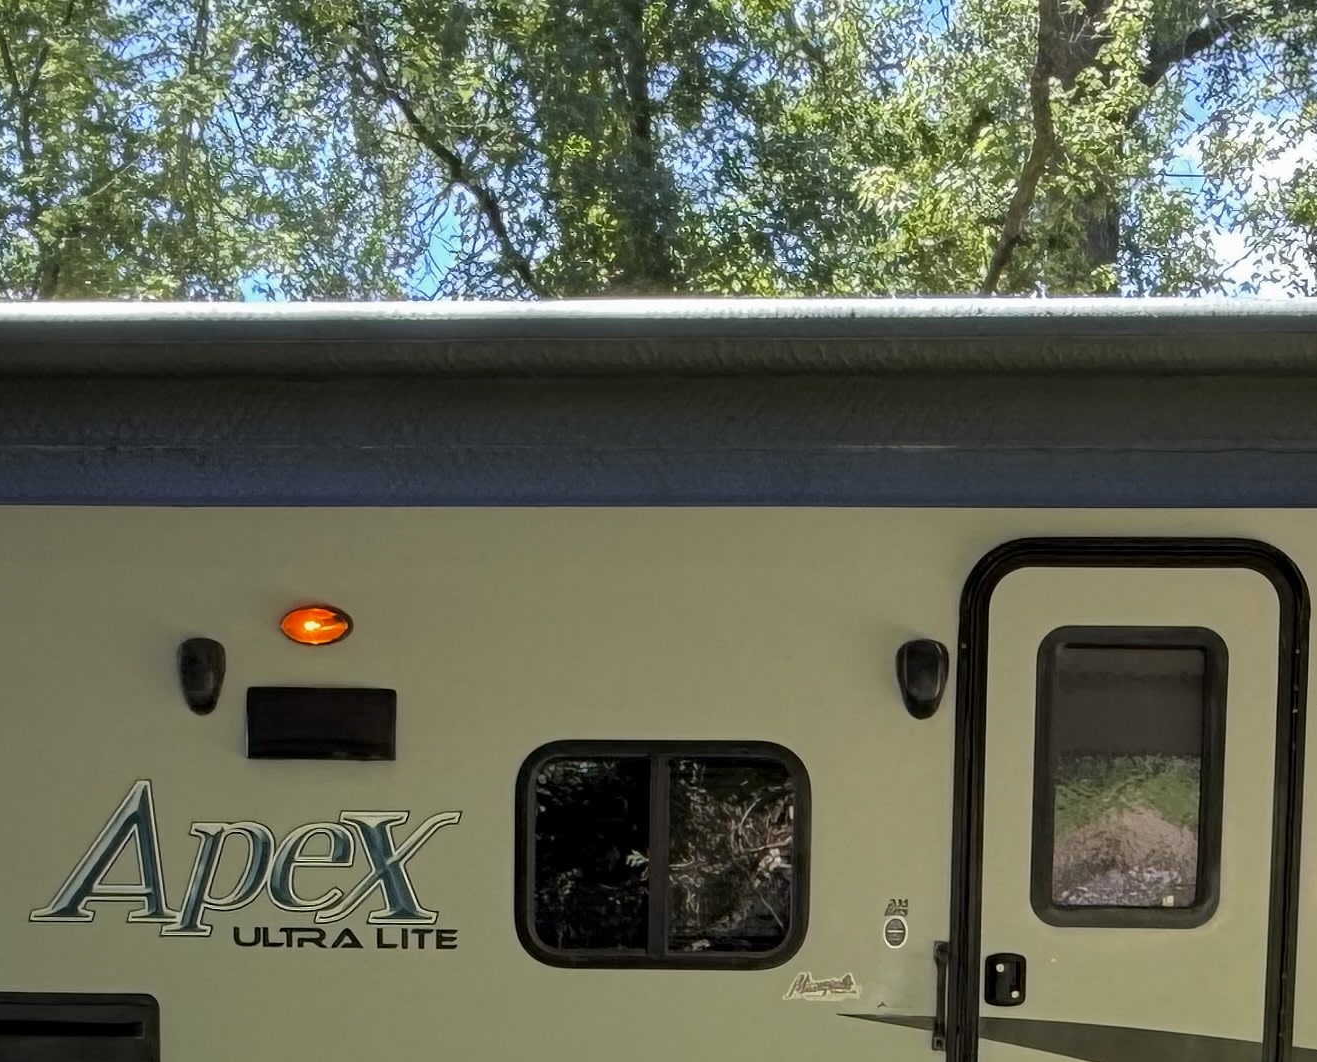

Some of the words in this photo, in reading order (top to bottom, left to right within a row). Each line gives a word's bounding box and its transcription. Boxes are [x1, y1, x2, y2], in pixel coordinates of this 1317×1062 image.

[28, 779, 463, 937] Apex
[233, 927, 364, 949] ULTRA
[377, 928, 459, 949] LITE
